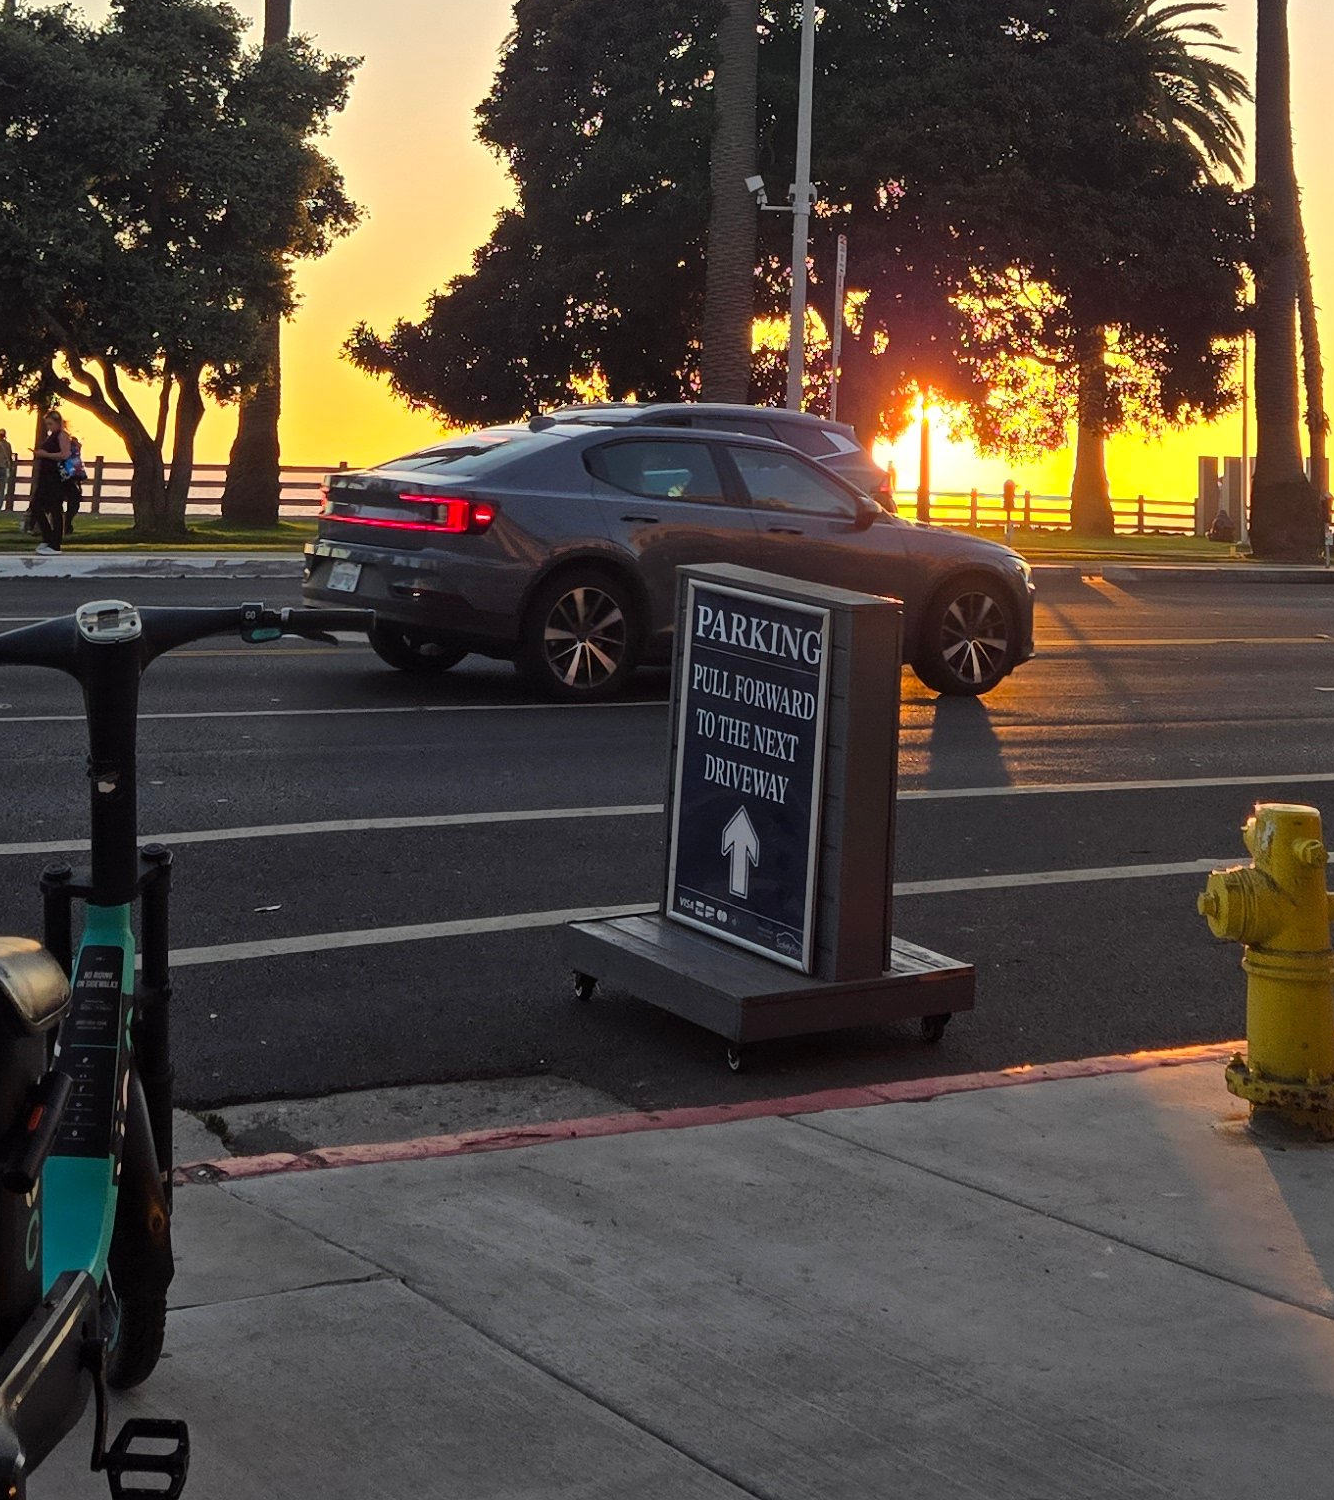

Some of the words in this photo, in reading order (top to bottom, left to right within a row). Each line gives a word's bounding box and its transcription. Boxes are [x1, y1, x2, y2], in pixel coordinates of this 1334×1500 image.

[245, 610, 256, 620] GO
[696, 605, 822, 665] PARKING
[692, 663, 731, 699] PULL
[734, 674, 815, 720] FORWARD
[696, 708, 715, 738] TO
[718, 715, 751, 749] THE
[753, 725, 799, 762] NEXT
[704, 754, 789, 804] DRIVEWAY
[679, 896, 694, 910] VISA
